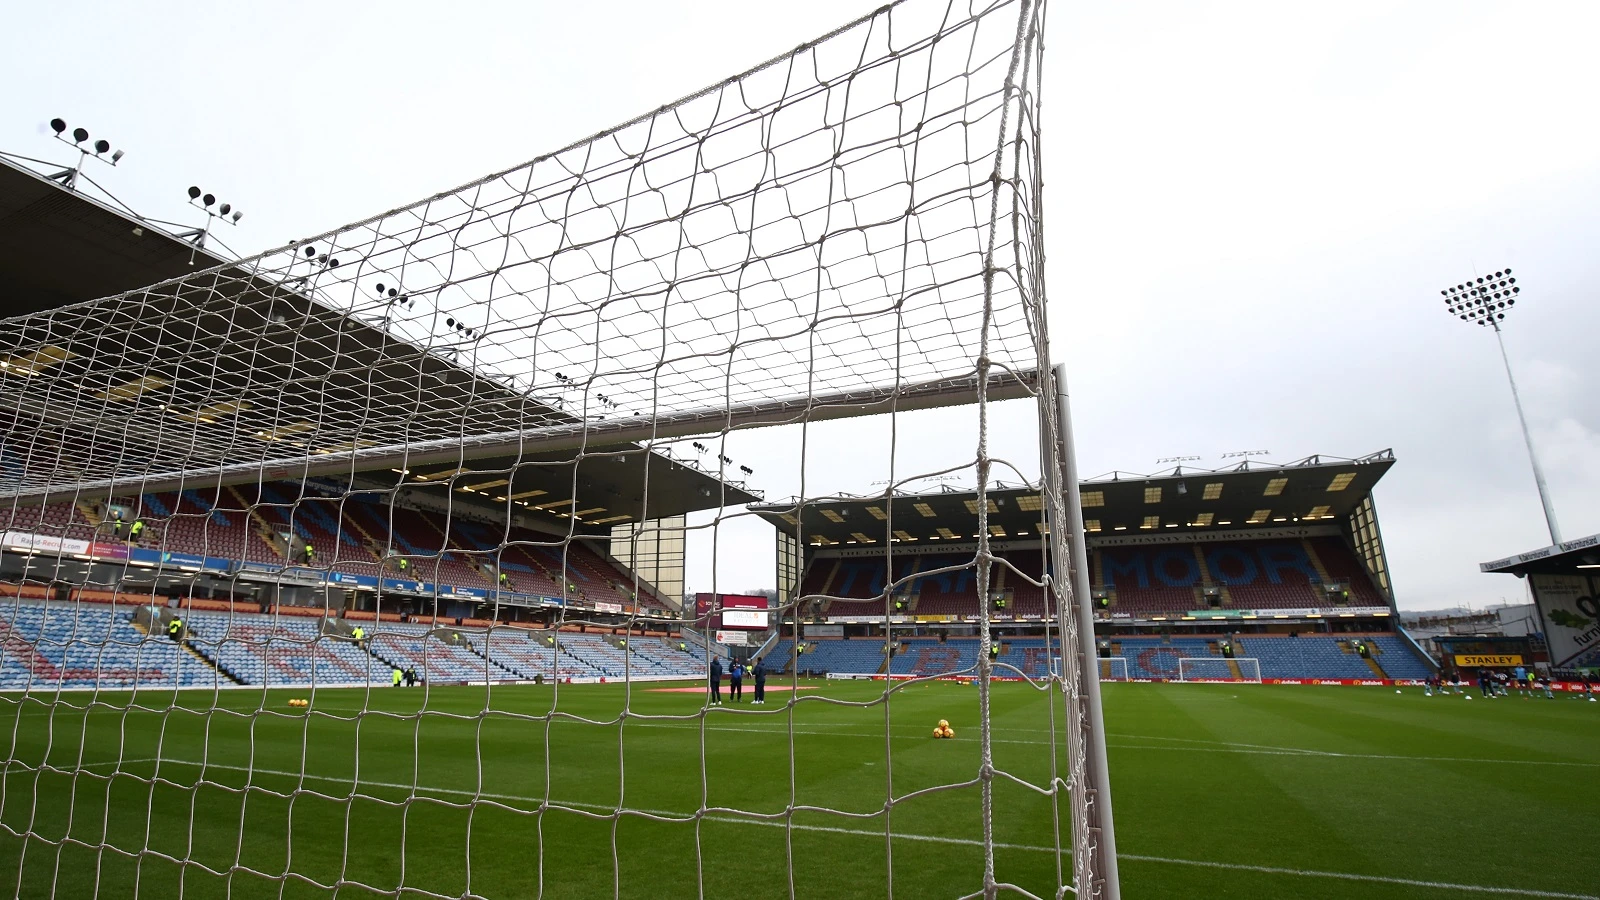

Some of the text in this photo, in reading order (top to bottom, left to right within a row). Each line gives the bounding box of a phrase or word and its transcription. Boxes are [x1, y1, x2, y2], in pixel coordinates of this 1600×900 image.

[1130, 536, 1183, 544] JIMMY
[1256, 529, 1309, 538] STAND
[1101, 547, 1322, 588] MOOR
[1464, 656, 1513, 664] STANLEY
